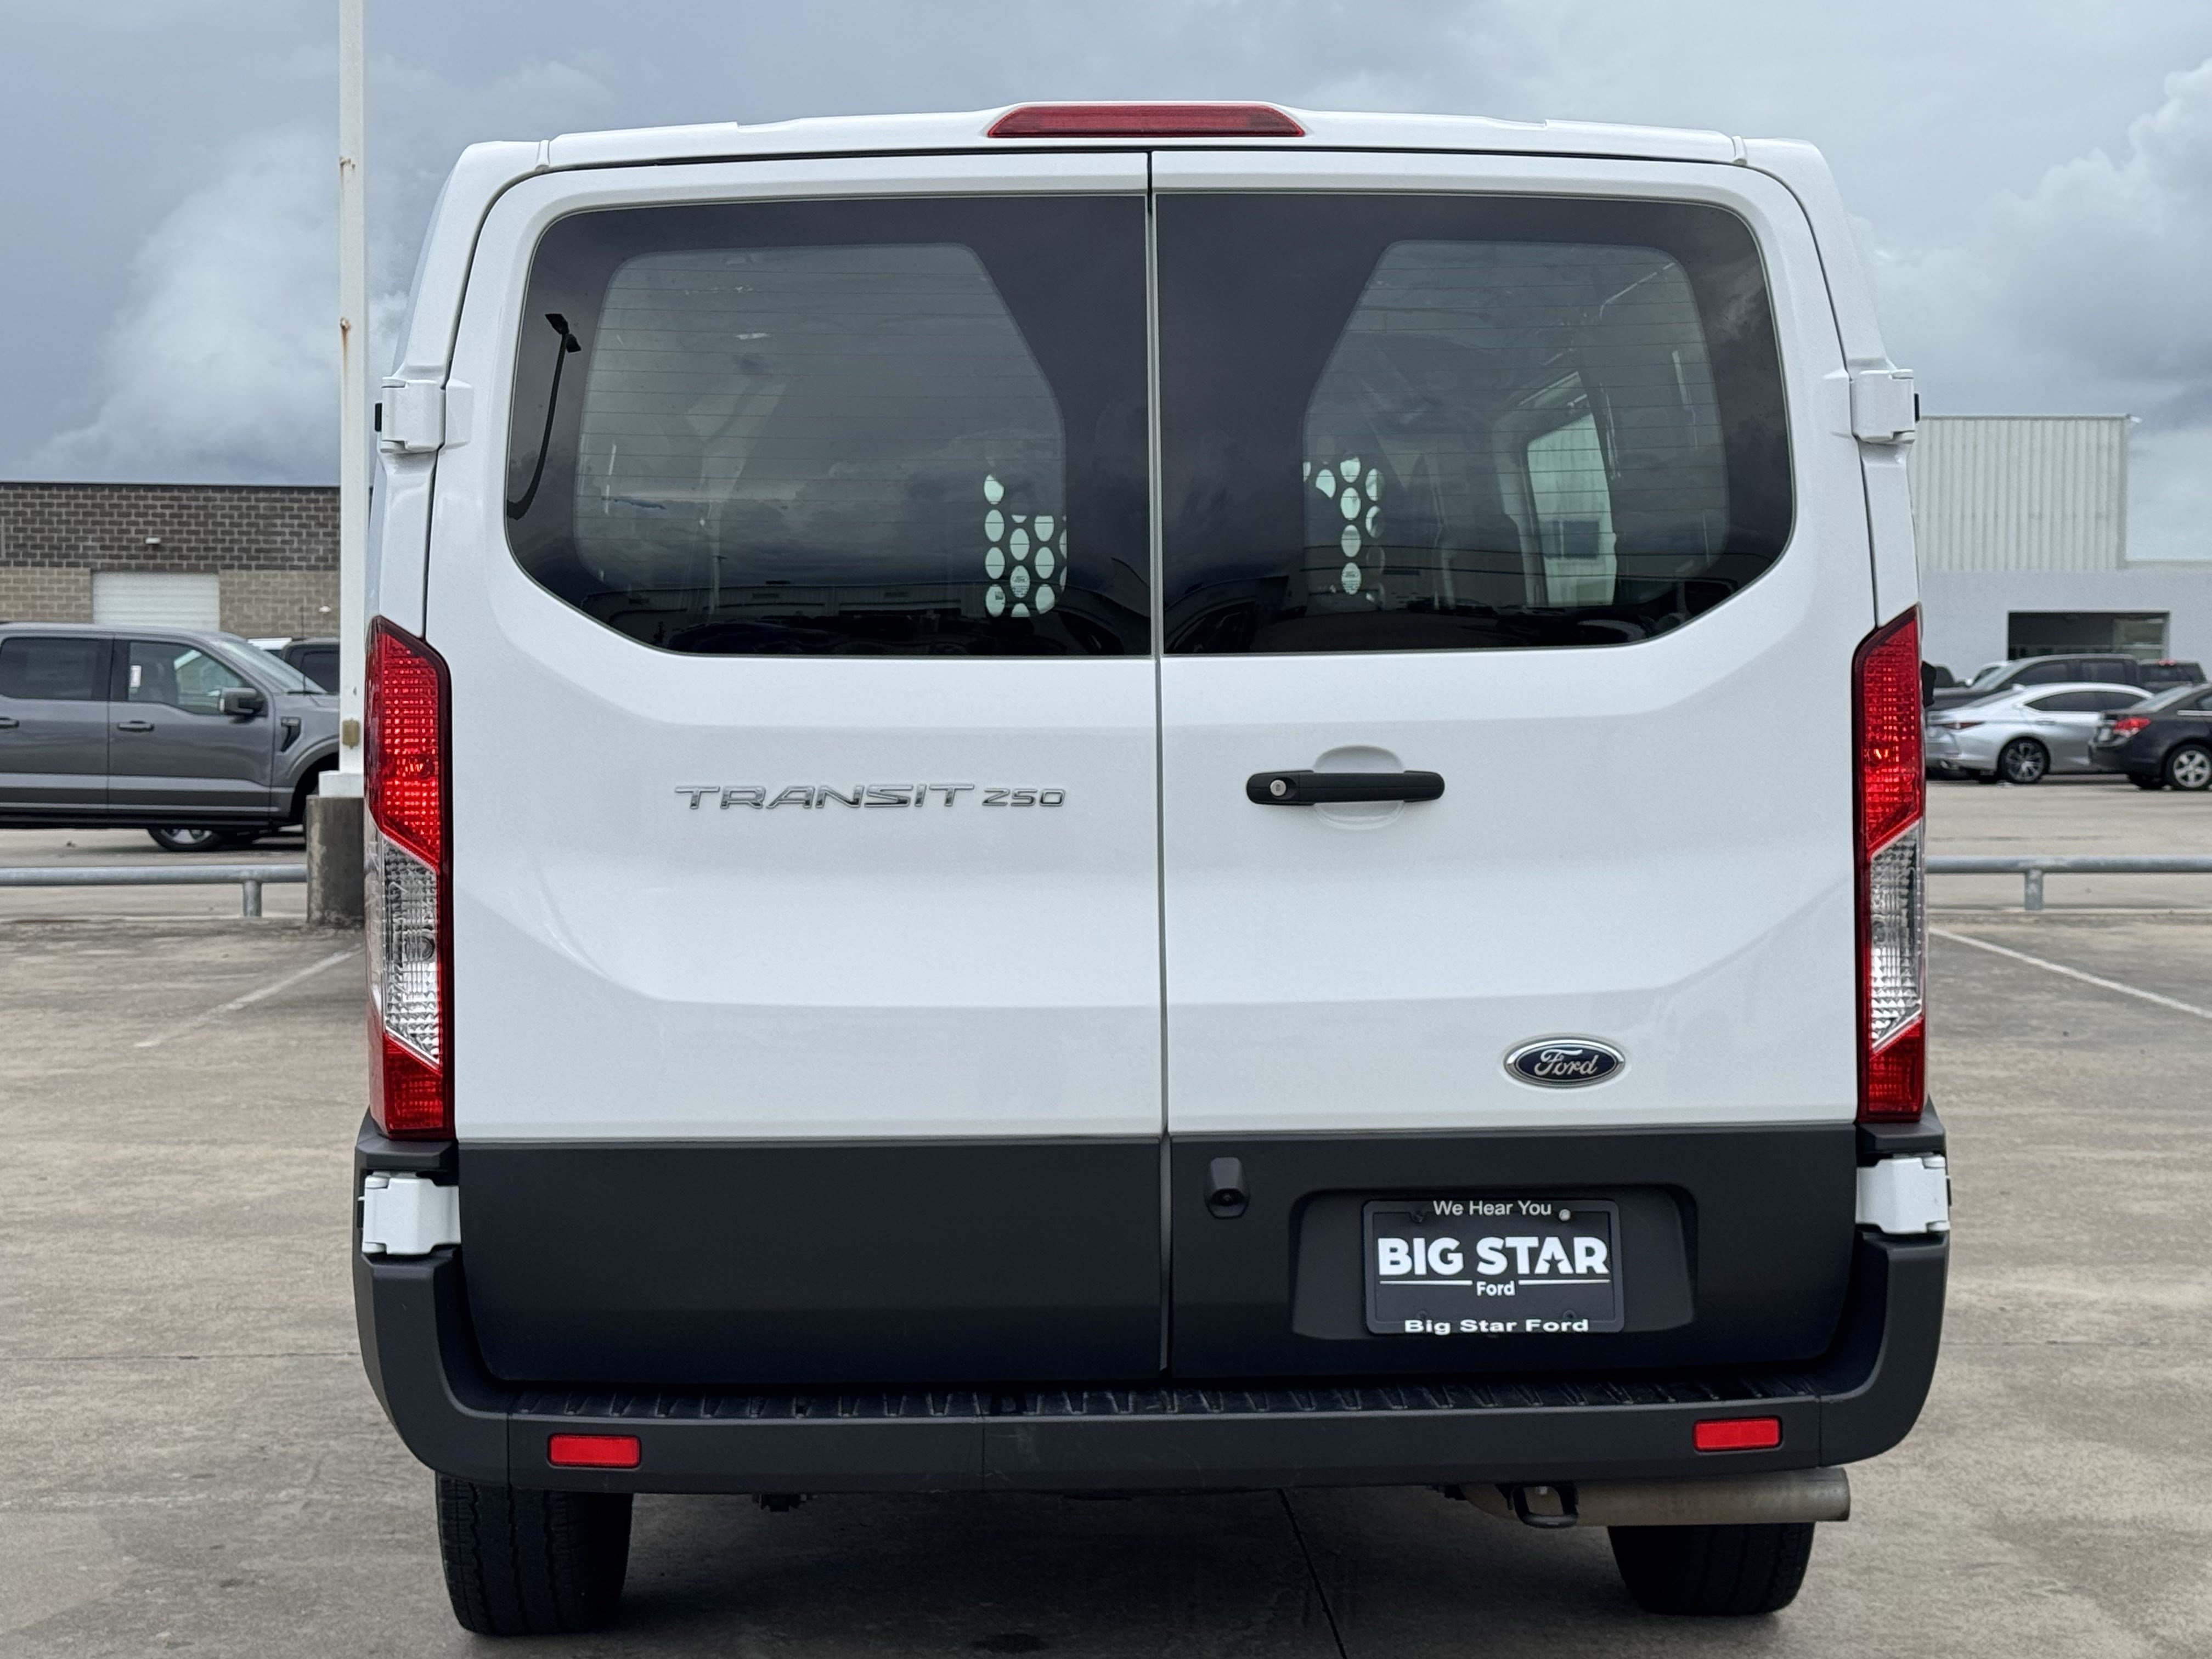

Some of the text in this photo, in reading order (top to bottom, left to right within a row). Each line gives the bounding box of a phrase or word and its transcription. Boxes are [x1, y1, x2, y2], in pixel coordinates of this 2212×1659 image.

[675, 782, 1066, 809] TRANSIT 250
[1534, 1048, 1599, 1076] Ford
[1433, 1200, 1552, 1216] We Hear You
[1378, 1236, 1610, 1276] BIG STAR
[1476, 1280, 1516, 1297] Ford
[1404, 1318, 1589, 1336] Big Star Ford
